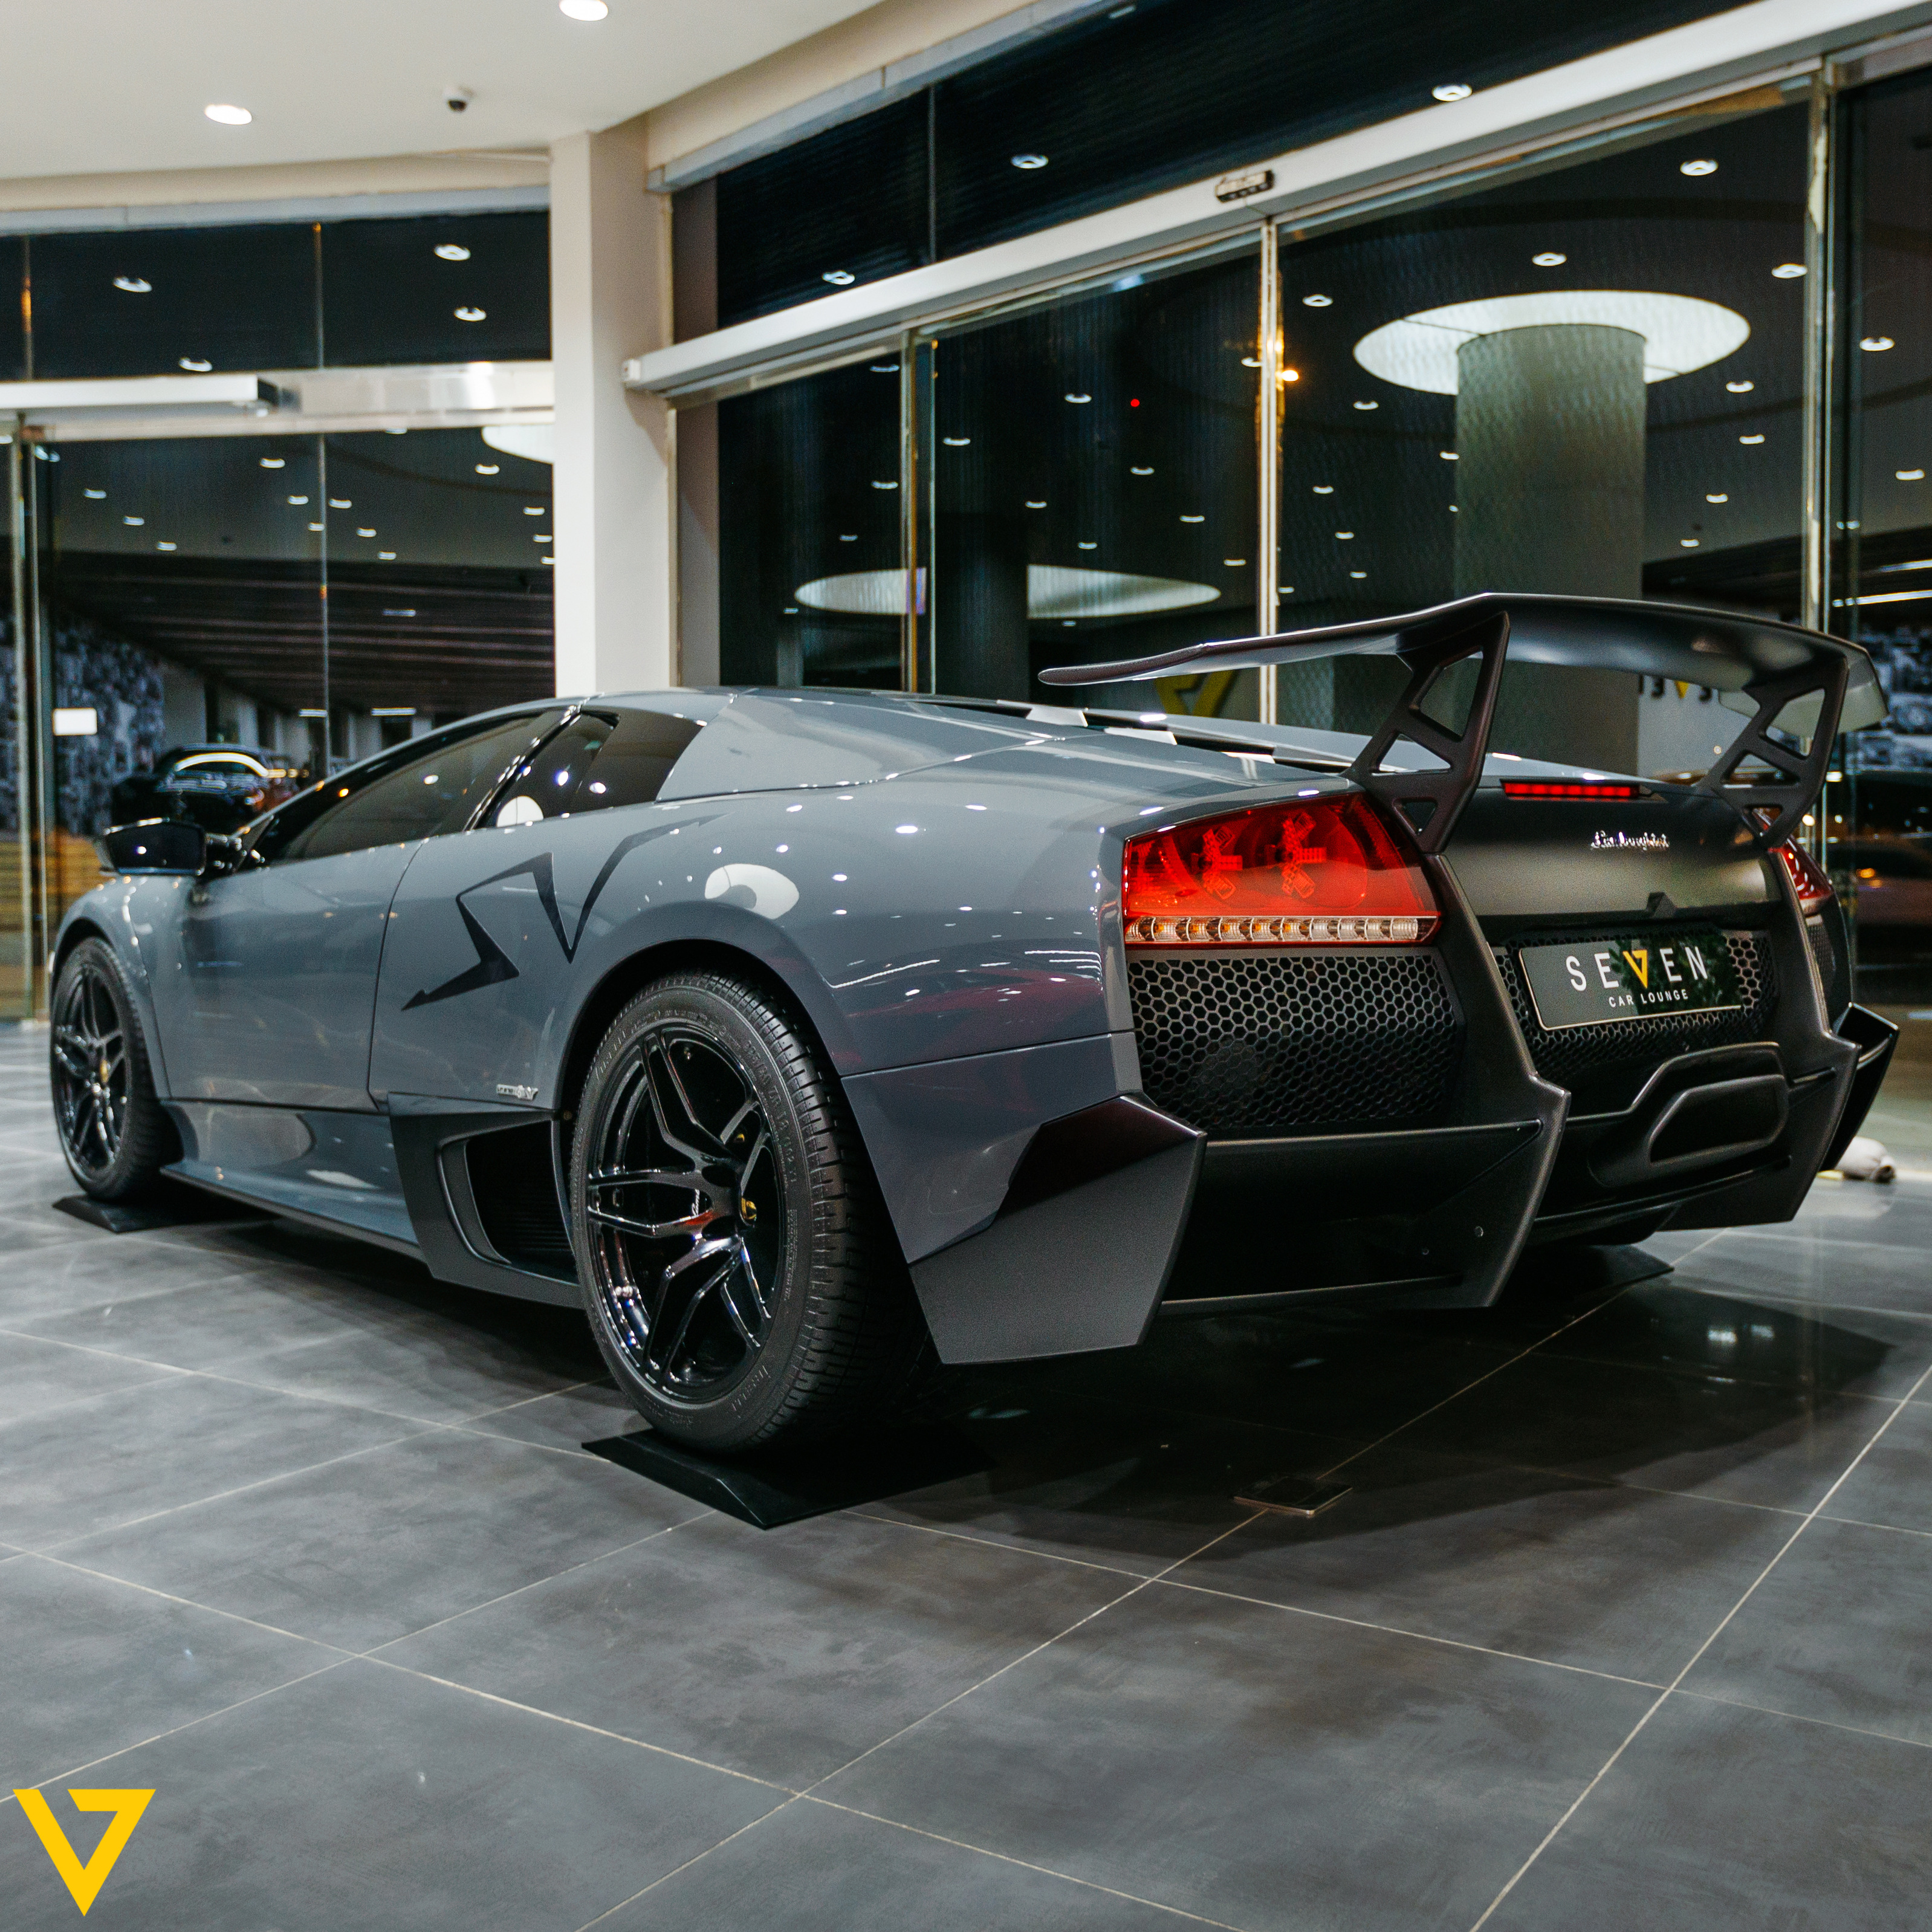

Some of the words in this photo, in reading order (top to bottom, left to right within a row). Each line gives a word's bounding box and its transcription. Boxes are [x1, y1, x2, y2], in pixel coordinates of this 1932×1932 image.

[1566, 946, 1708, 991] SEVEN
[1609, 996, 1633, 1008] CAR
[1641, 988, 1688, 1004] LOUNGE
